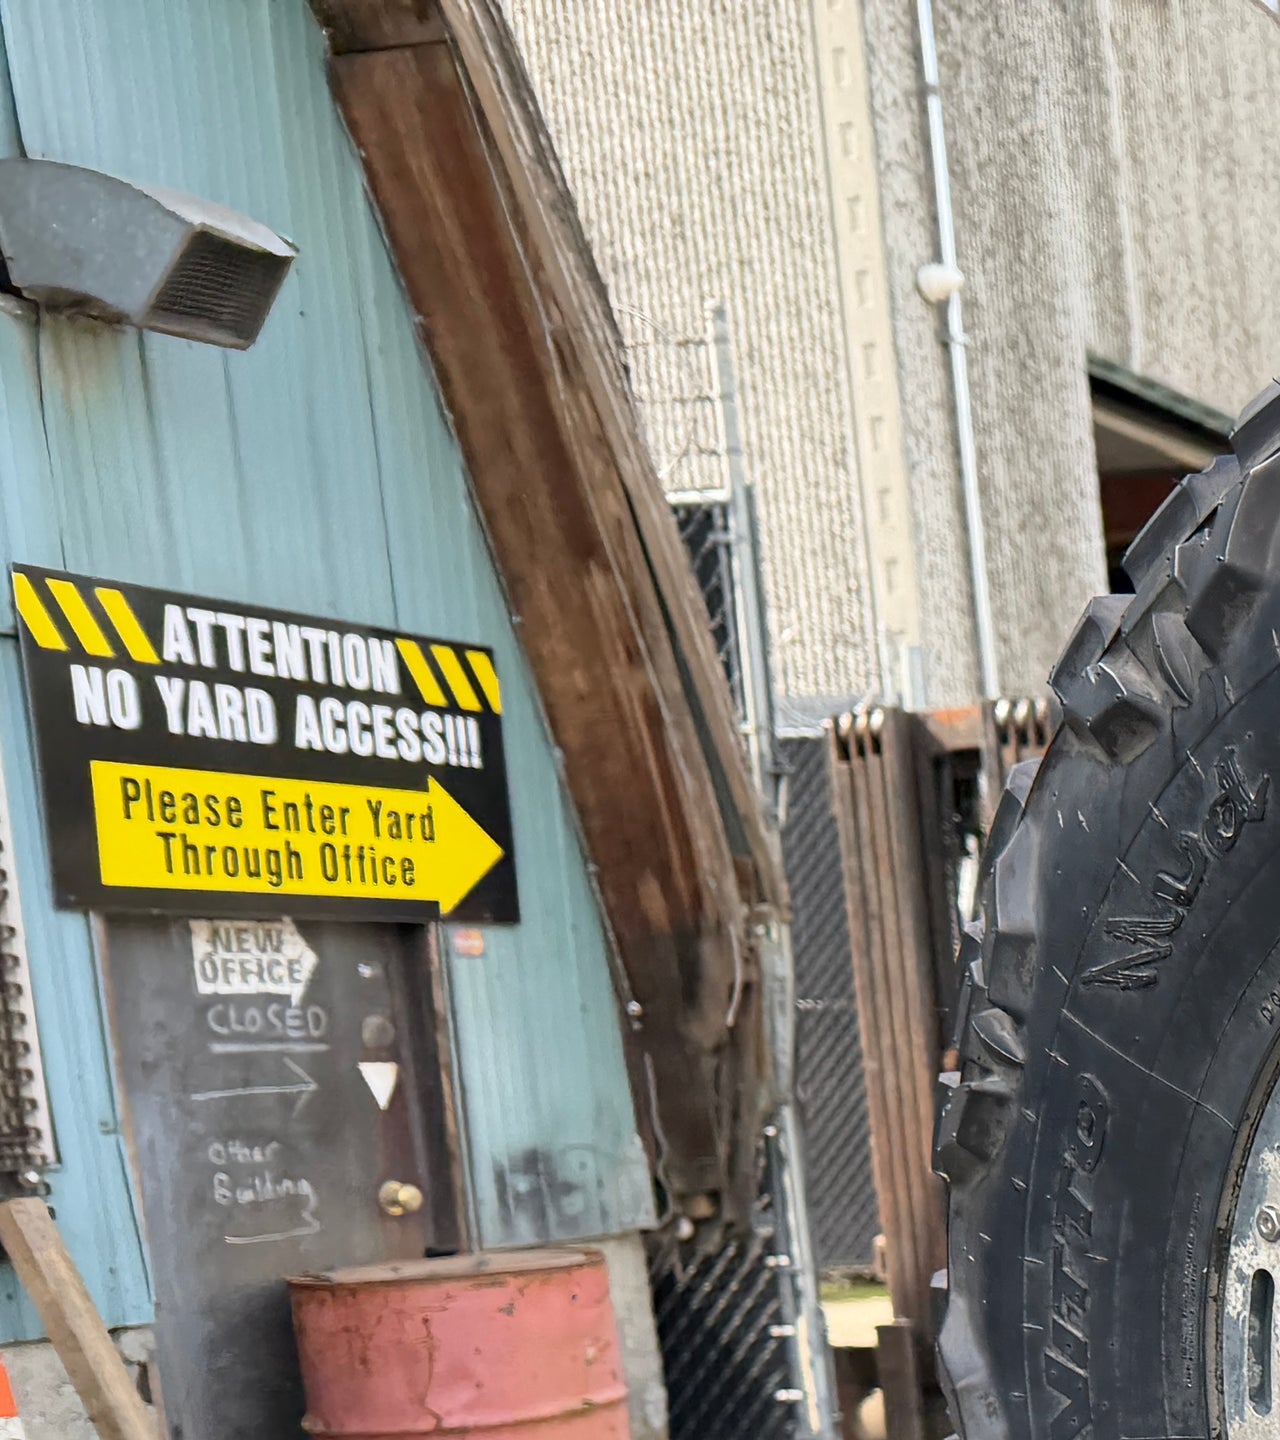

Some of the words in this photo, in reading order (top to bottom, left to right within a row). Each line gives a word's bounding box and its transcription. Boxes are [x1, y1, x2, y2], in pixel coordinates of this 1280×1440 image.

[163, 603, 401, 694] ATTENTION
[70, 664, 142, 731] NO
[154, 675, 279, 745] YARD
[294, 698, 484, 769] ACCESS!!!
[119, 776, 244, 829] Please
[260, 788, 351, 837] Enter
[366, 798, 438, 844] Yard
[156, 831, 304, 888] Through
[319, 842, 416, 887] Office
[1080, 744, 1271, 994] Mud
[200, 956, 306, 985] OFFICE
[210, 926, 285, 955] NEW
[207, 1003, 328, 1038] CLOSED
